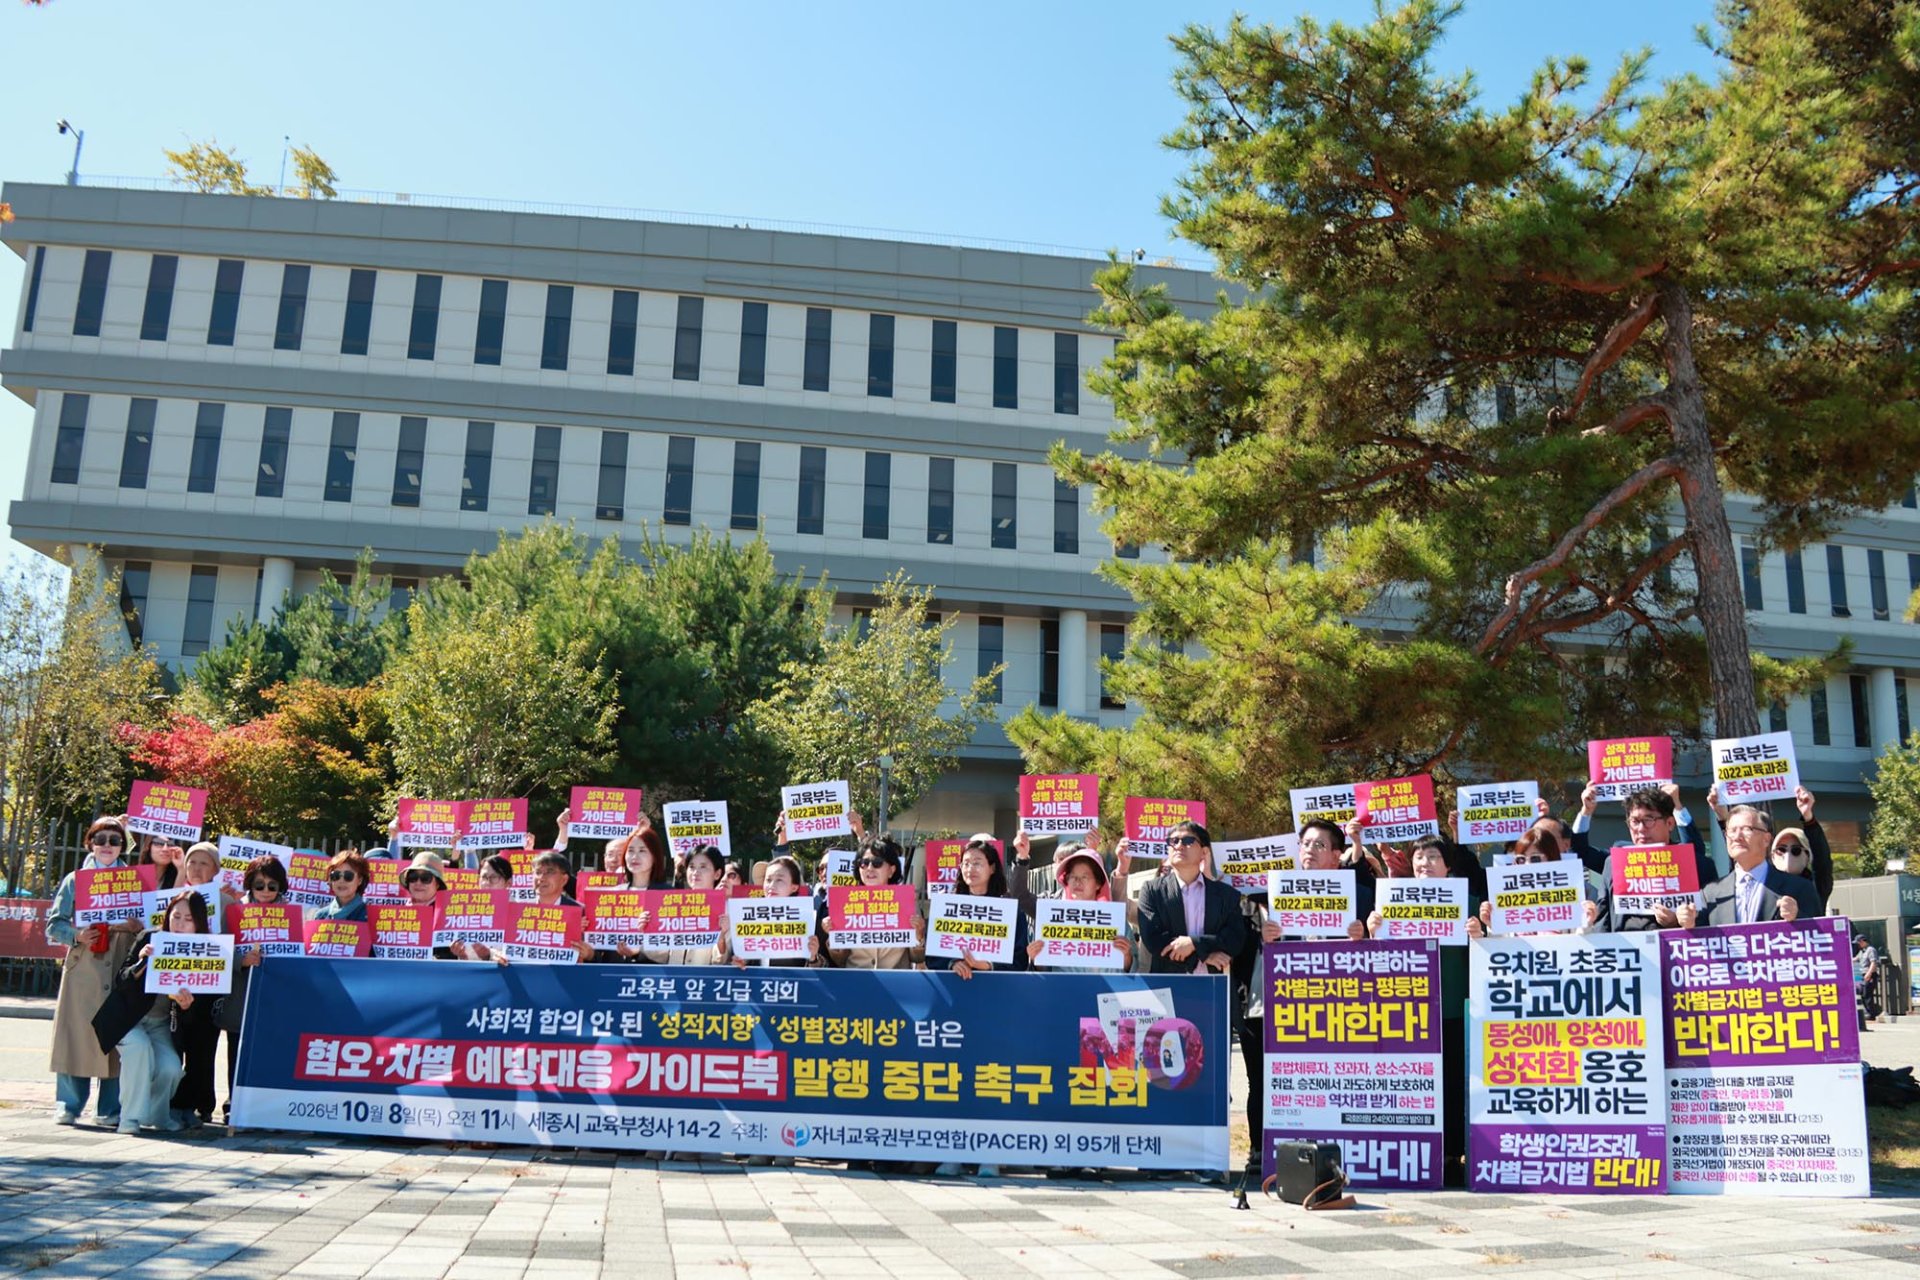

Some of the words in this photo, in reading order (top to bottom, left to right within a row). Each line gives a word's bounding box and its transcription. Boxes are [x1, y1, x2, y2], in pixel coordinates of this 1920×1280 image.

[1721, 744, 1779, 764] 교육부는
[1718, 760, 1789, 780] 2022교육과정
[1036, 779, 1055, 790] 성적
[1058, 779, 1078, 789] 지향
[1725, 776, 1786, 796] 준수하라!
[150, 787, 168, 798] 성적
[171, 788, 190, 800] 지향
[791, 790, 837, 806] 교육부는
[1031, 791, 1050, 802] 성별
[1053, 791, 1083, 802] 정체성
[143, 795, 163, 807] 성별
[165, 798, 192, 811] 정체성
[474, 803, 491, 812] 성적
[494, 802, 511, 811] 지향
[788, 804, 843, 819] 2022교육과정
[1032, 802, 1082, 816] 가이드북
[141, 806, 189, 823] 가이드북
[470, 813, 488, 822] 성별
[490, 812, 514, 821] 정체성
[130, 817, 150, 830] 즉각
[152, 822, 195, 838] 중단하라!
[470, 821, 513, 833] 가이드북
[794, 817, 840, 833] 준수하라!
[1024, 819, 1044, 830] 즉각
[1047, 818, 1093, 830] 중단하라!
[461, 837, 479, 845] 즉각
[482, 834, 522, 844] 중단하라!
[1280, 879, 1341, 895] 교육부는
[1503, 872, 1569, 891] 교육부는
[848, 890, 869, 901] 성적
[872, 890, 894, 901] 지향
[1274, 898, 1347, 910] 2022교육과정
[1497, 889, 1576, 908] 2022교육과정
[742, 906, 800, 921] 교육부는
[843, 902, 864, 914] 성별
[868, 902, 899, 913] 정체성
[944, 903, 1003, 922] 교육부는
[1505, 906, 1572, 926] 준수하라!
[737, 923, 806, 935] 2022교육과정
[845, 915, 898, 929] 가이드북
[935, 920, 1007, 937] 2022교육과정
[1280, 913, 1342, 928] 준수하라!
[744, 938, 802, 952] 준수하라!
[834, 933, 857, 944] 즉각
[861, 932, 910, 944] 중단하라!
[940, 935, 1000, 954] 준수하라!
[1670, 935, 1748, 961] 자국민을
[1751, 930, 1833, 956] 다수라는
[162, 942, 220, 956] 교육부는
[154, 959, 225, 970] 2022교육과정
[1273, 952, 1329, 975] 자국민
[1333, 950, 1429, 973] 역차별하는
[1488, 951, 1563, 976] 유치원,
[1570, 948, 1642, 974] 초중고
[158, 973, 219, 986] 준수하라!
[1670, 963, 1730, 987] 이유로
[1733, 957, 1837, 983] 역차별하는
[618, 978, 676, 999] 교육부
[685, 979, 705, 1000] 앞
[713, 979, 751, 1001] 긴급
[760, 981, 798, 1004] 집회
[1274, 977, 1359, 998] 차별금지법
[1376, 976, 1429, 997] 평등법
[1488, 976, 1641, 1018] 학교에서
[1673, 987, 1762, 1011] 차별금지법
[1780, 984, 1838, 1006] 평등법
[466, 1007, 533, 1033] 사회적
[539, 1009, 584, 1036] 합의
[590, 1010, 613, 1037] 안
[619, 1011, 642, 1038] 된
[914, 1020, 964, 1048] 담은
[1274, 1002, 1429, 1042] 반대한다!
[1488, 1022, 1561, 1048] 동성애,
[1567, 1021, 1643, 1047] 양성애,
[1674, 1010, 1840, 1056] 반대한다!
[1080, 1017, 1204, 1089] NO
[305, 1039, 455, 1081] 혐오·차별
[465, 1046, 612, 1089] 예방대응
[626, 1053, 779, 1096] 가이드북
[793, 1057, 869, 1099] 발행
[883, 1061, 962, 1102] 중단
[975, 1063, 1053, 1104] 촉구
[1068, 1065, 1148, 1107] 집회
[1272, 1062, 1331, 1074] 불법체류자,
[1335, 1063, 1371, 1075] 전과자,
[1375, 1063, 1434, 1075] 성소수자를
[1488, 1051, 1578, 1085] 성전환
[1584, 1051, 1647, 1083] 옹호
[1271, 1078, 1294, 1090] 취업,
[1298, 1079, 1341, 1091] 승진에서
[1343, 1079, 1387, 1091] 과도하게
[1390, 1079, 1434, 1091] 보호하여
[1272, 1096, 1291, 1107] 일반
[1295, 1095, 1326, 1107] 국민을
[1329, 1094, 1367, 1108] 역차별
[1371, 1095, 1397, 1108] 받게
[1399, 1096, 1421, 1108] 하는
[1424, 1096, 1434, 1109] 법
[1487, 1087, 1589, 1115] 교육하게
[1595, 1087, 1647, 1114] 하는
[287, 1102, 338, 1121] 2026년
[342, 1100, 384, 1123] 10월
[388, 1103, 441, 1127] 8일(목)
[446, 1112, 476, 1128] 오전
[481, 1109, 515, 1130] 11시
[528, 1112, 579, 1134] 세종시
[584, 1115, 673, 1138] 교육부청사
[678, 1120, 720, 1139] 14-2
[731, 1123, 767, 1142] 주최:
[812, 1125, 1048, 1153] 자녀교육권부모연합(PACER)
[1054, 1134, 1070, 1152] 외
[1077, 1135, 1120, 1155] 95개
[1126, 1136, 1161, 1155] 단체
[1499, 1133, 1640, 1159] 학생인권조례,
[1476, 1160, 1589, 1186] 차별금지법
[1593, 1159, 1660, 1187] 반대!
